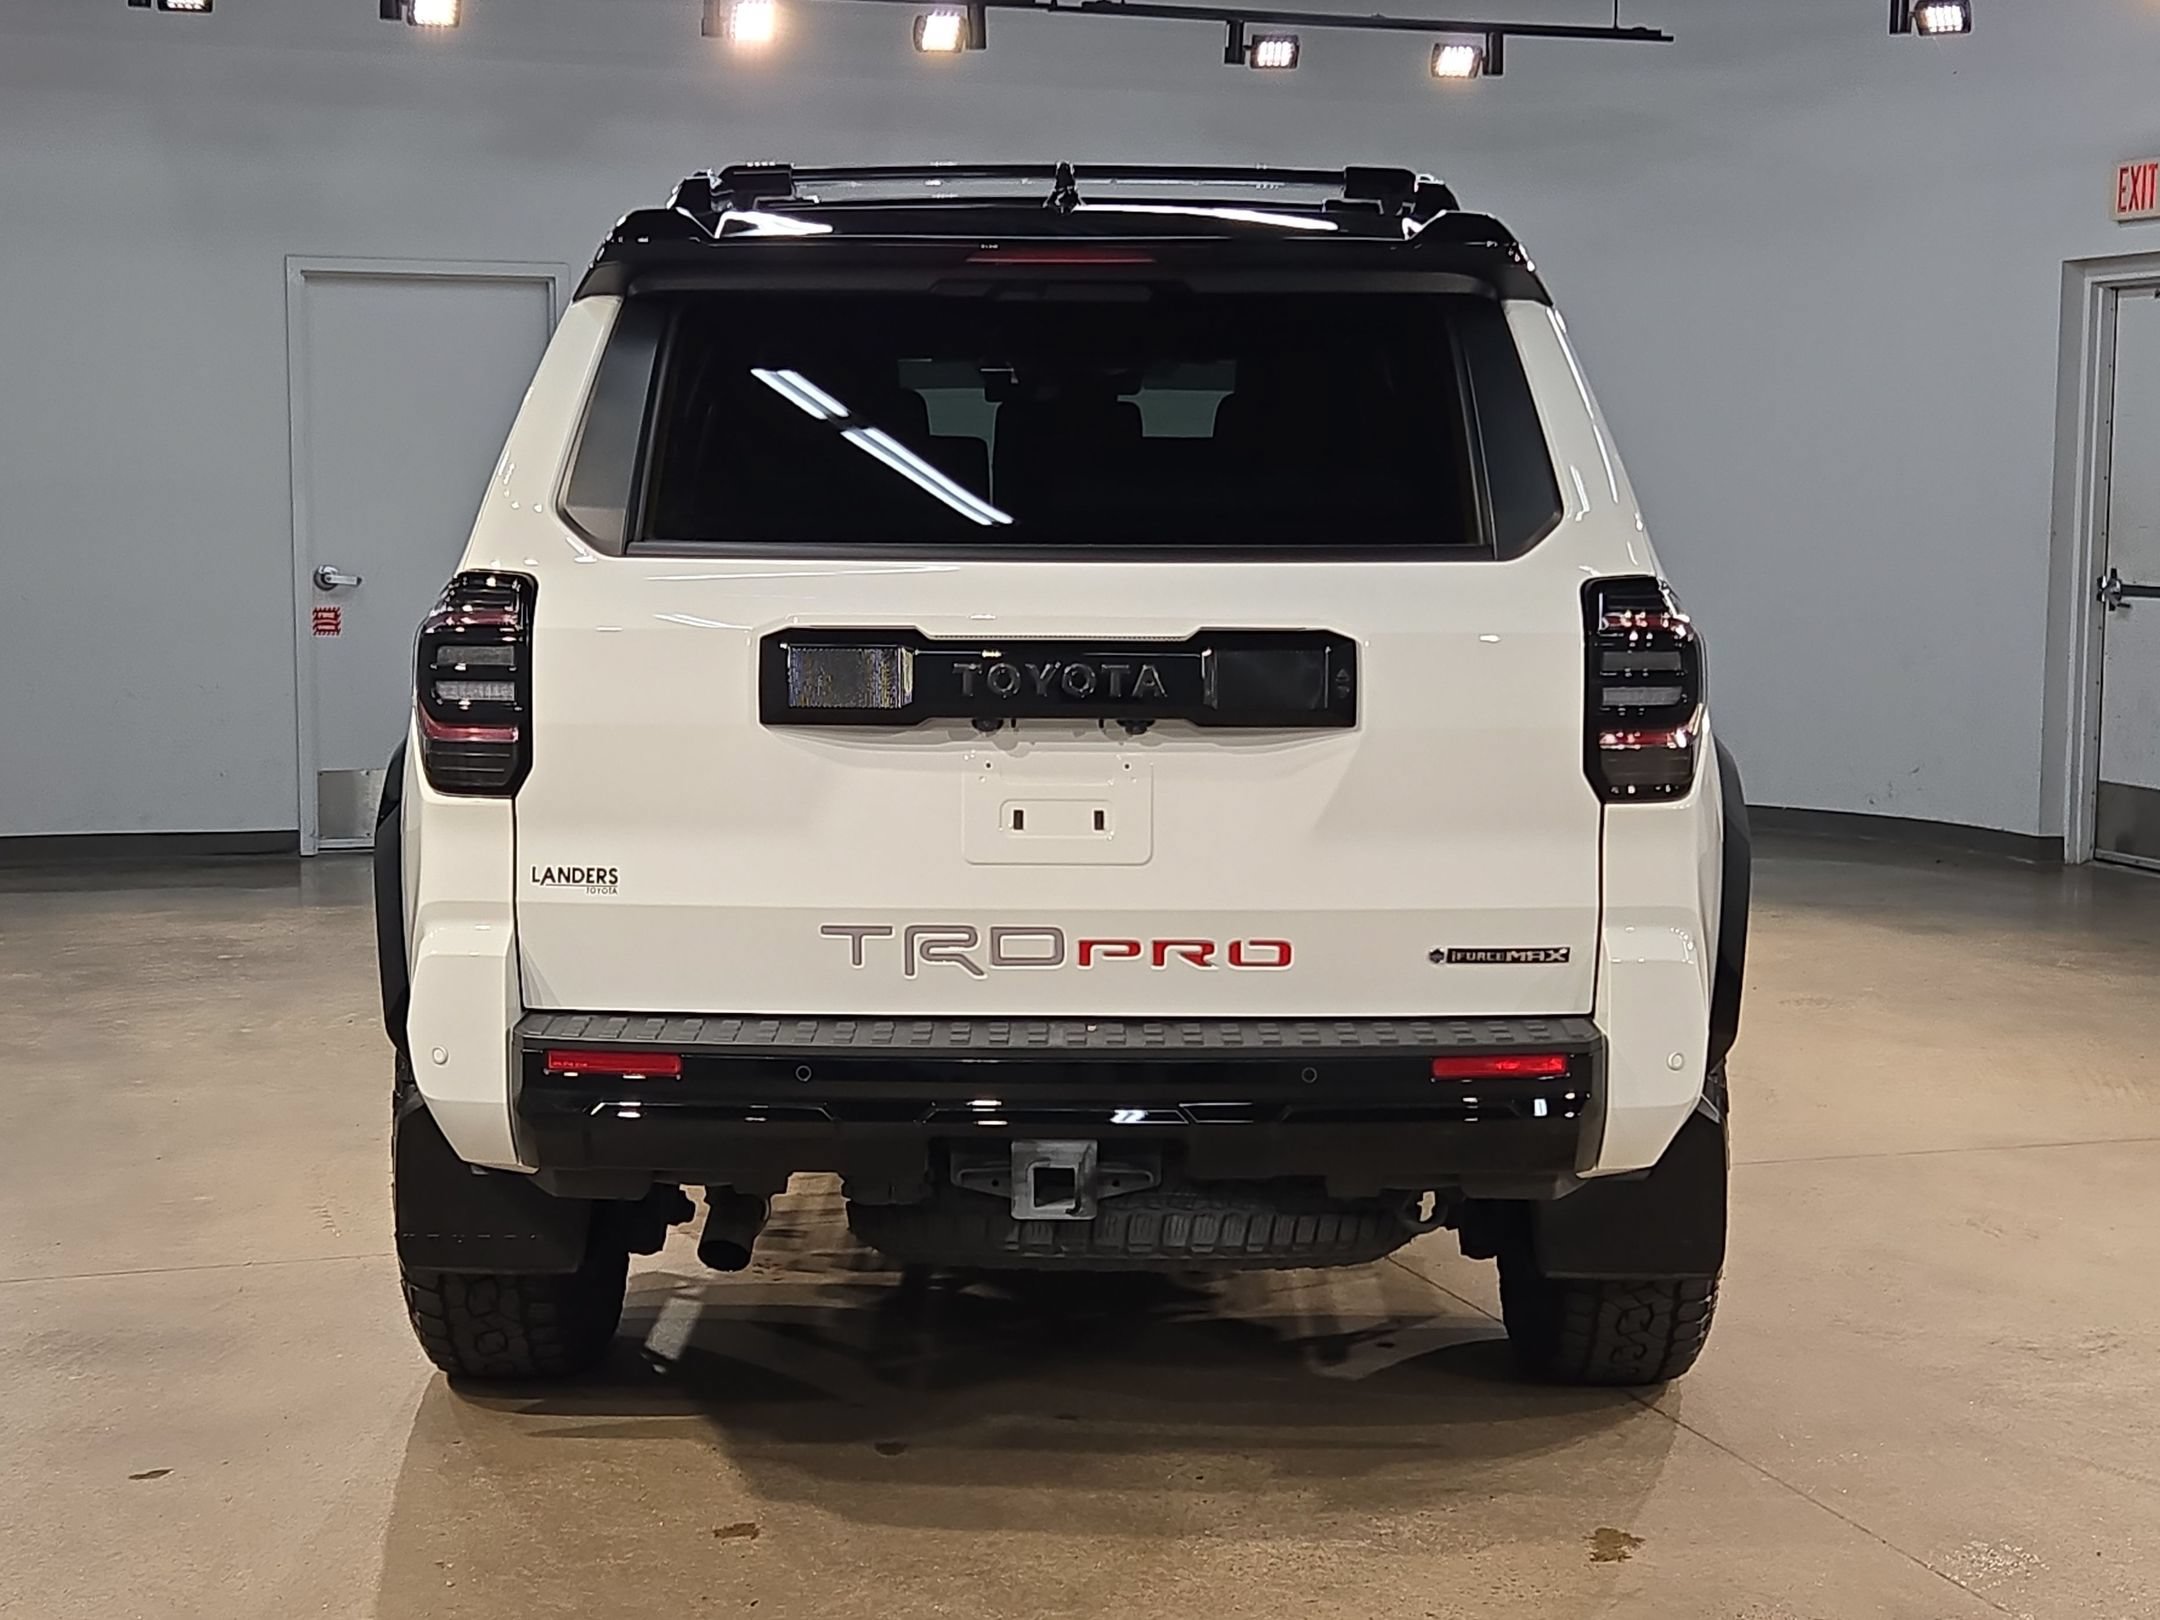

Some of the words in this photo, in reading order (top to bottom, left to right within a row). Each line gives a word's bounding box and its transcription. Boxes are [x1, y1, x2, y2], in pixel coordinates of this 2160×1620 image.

[2117, 163, 2159, 213] EXIT
[952, 662, 1168, 698] TOYOTA
[531, 866, 619, 886] LANDERS
[585, 886, 618, 895] TOYOTA
[820, 924, 1066, 977] TRD
[1077, 939, 1293, 968] PRO
